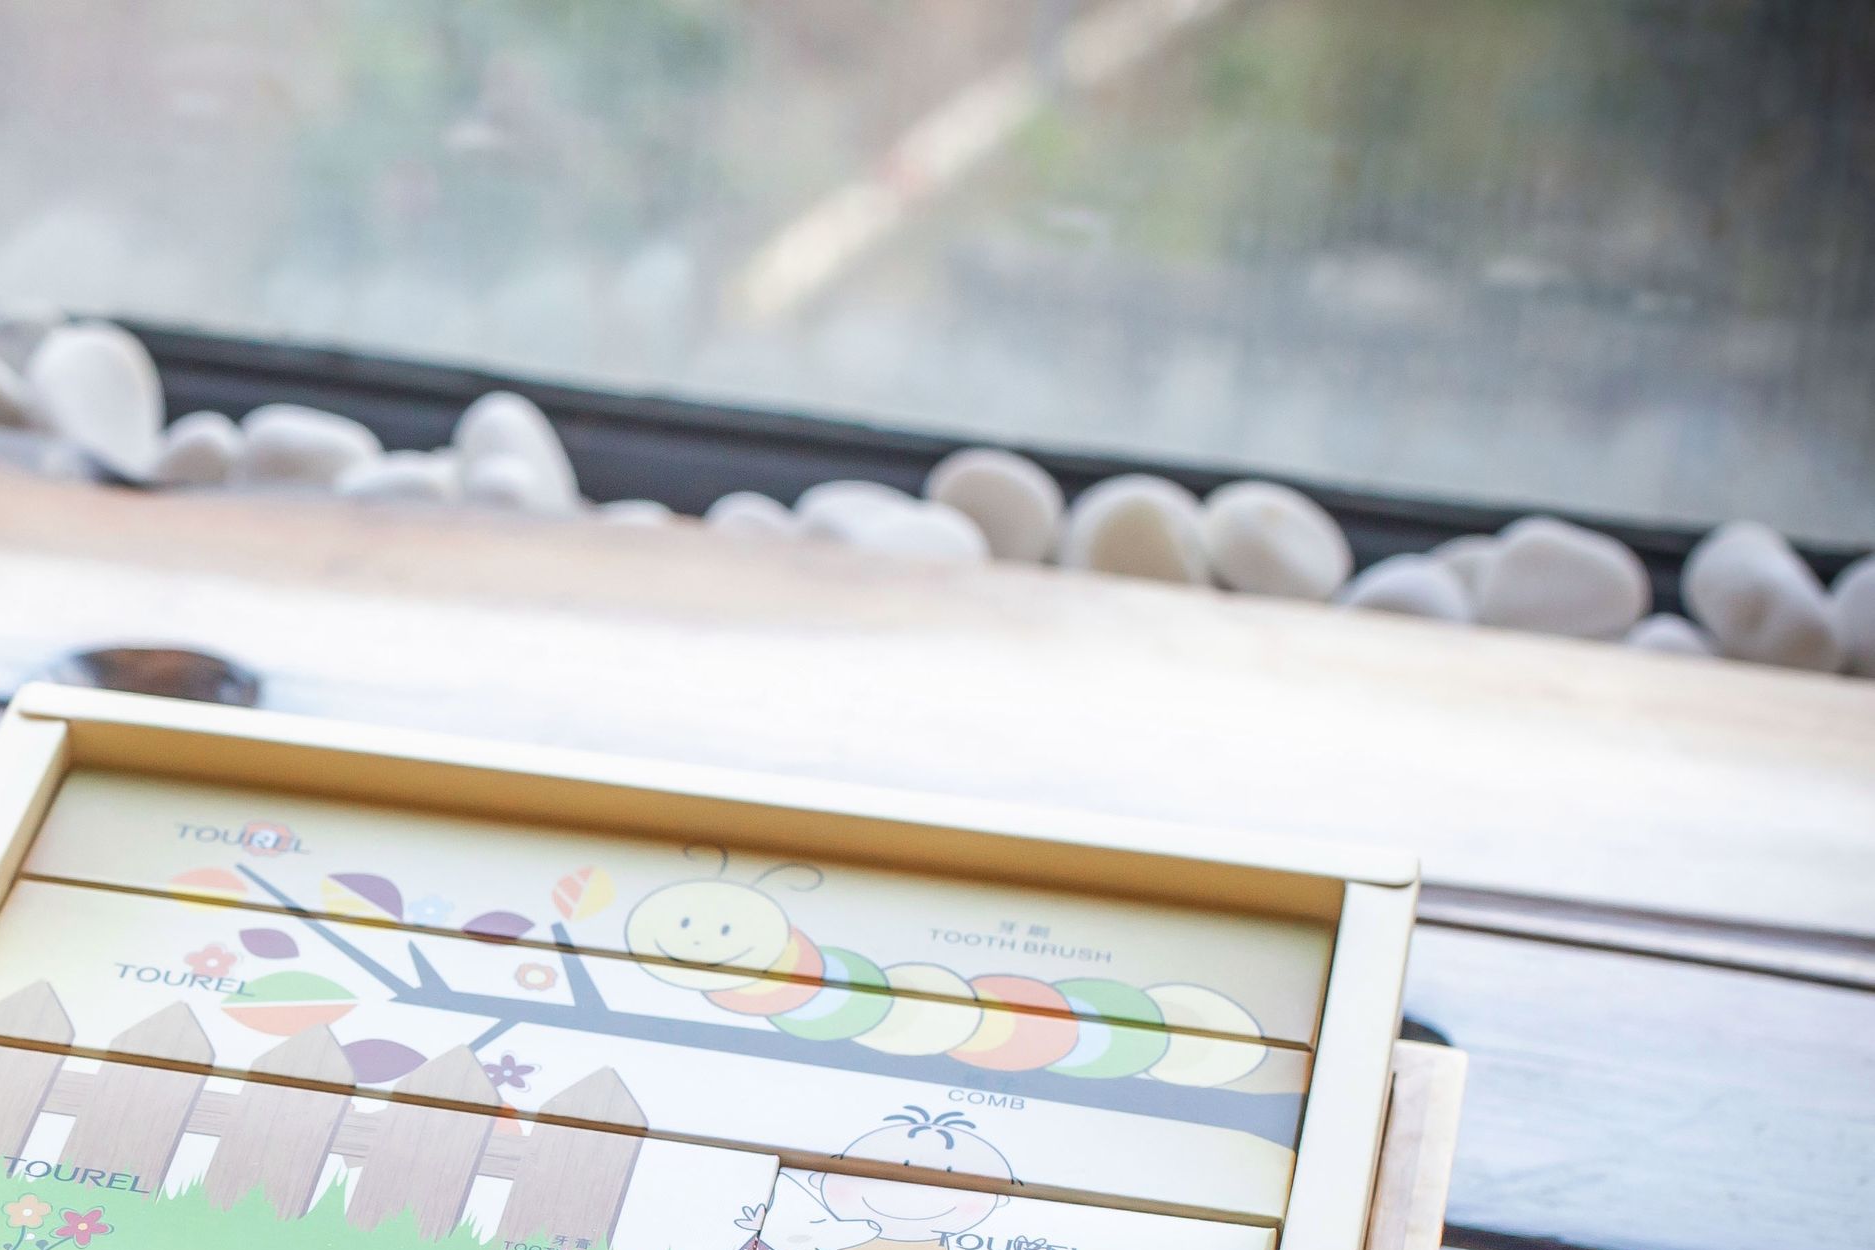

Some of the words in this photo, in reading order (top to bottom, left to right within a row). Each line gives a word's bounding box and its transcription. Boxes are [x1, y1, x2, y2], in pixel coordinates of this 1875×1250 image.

[930, 928, 1015, 950] TOOTH
[1023, 941, 1112, 963] BRUSH
[114, 962, 256, 997] TOUREL
[948, 1089, 1025, 1110] COMB
[4, 1156, 149, 1193] TOUREL
